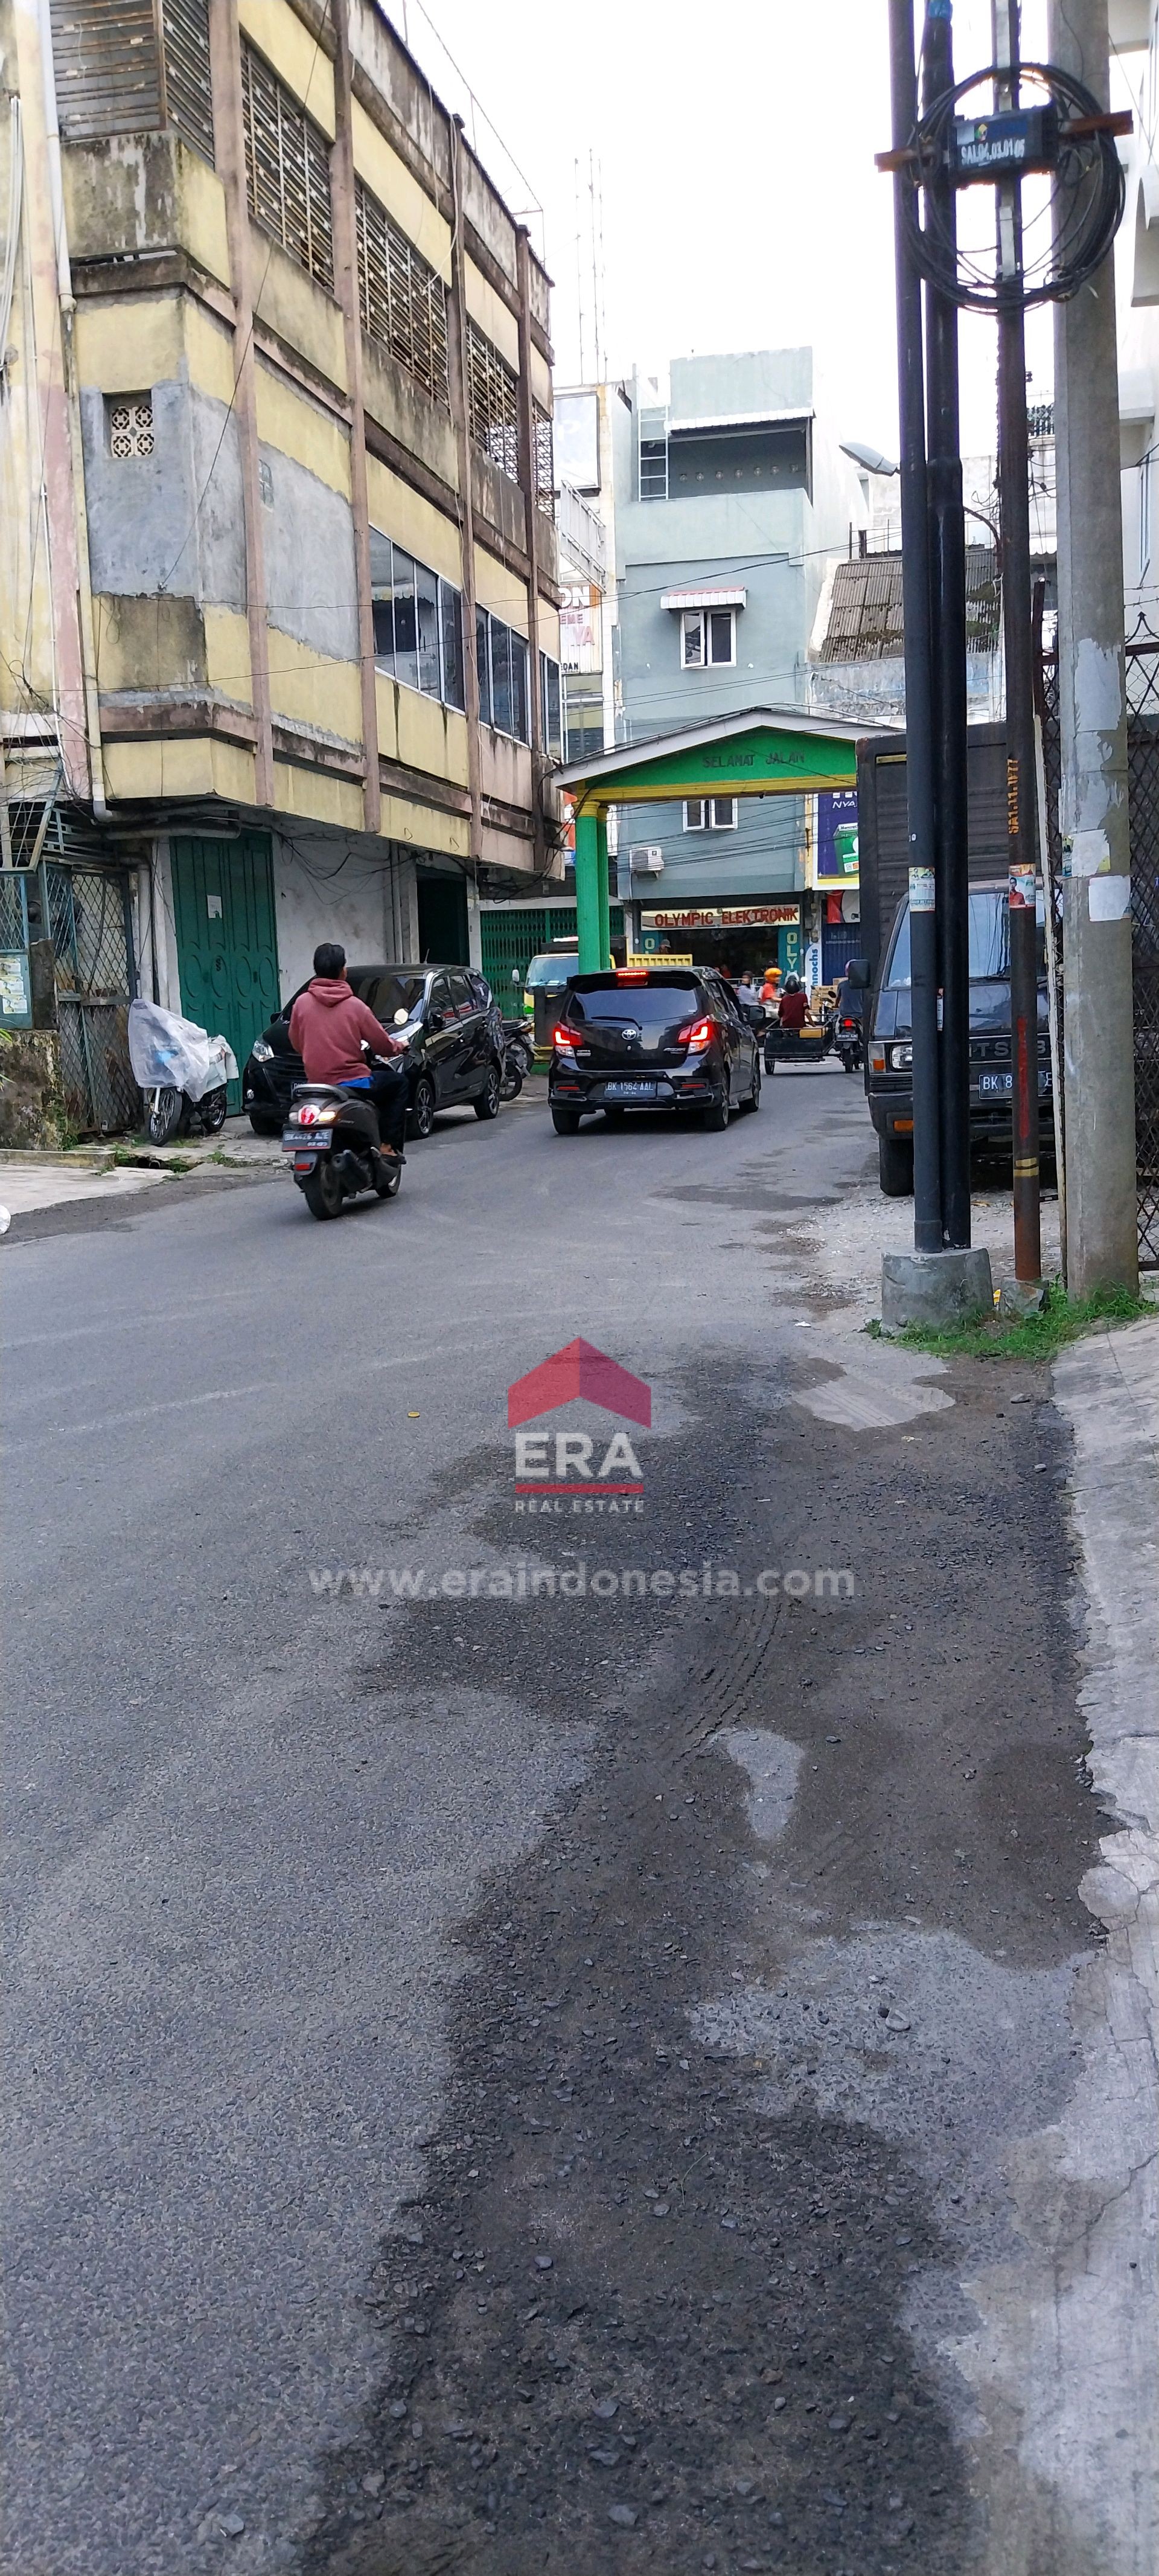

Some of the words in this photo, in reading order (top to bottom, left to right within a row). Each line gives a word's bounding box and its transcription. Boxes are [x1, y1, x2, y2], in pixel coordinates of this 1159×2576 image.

[703, 754, 755, 767] SELAMAT
[766, 751, 805, 764] JALAN
[654, 912, 714, 926] OLYMPIC
[721, 908, 798, 924] ELEKTRONIK
[607, 1082, 616, 1091] BK
[983, 1076, 998, 1090] BK
